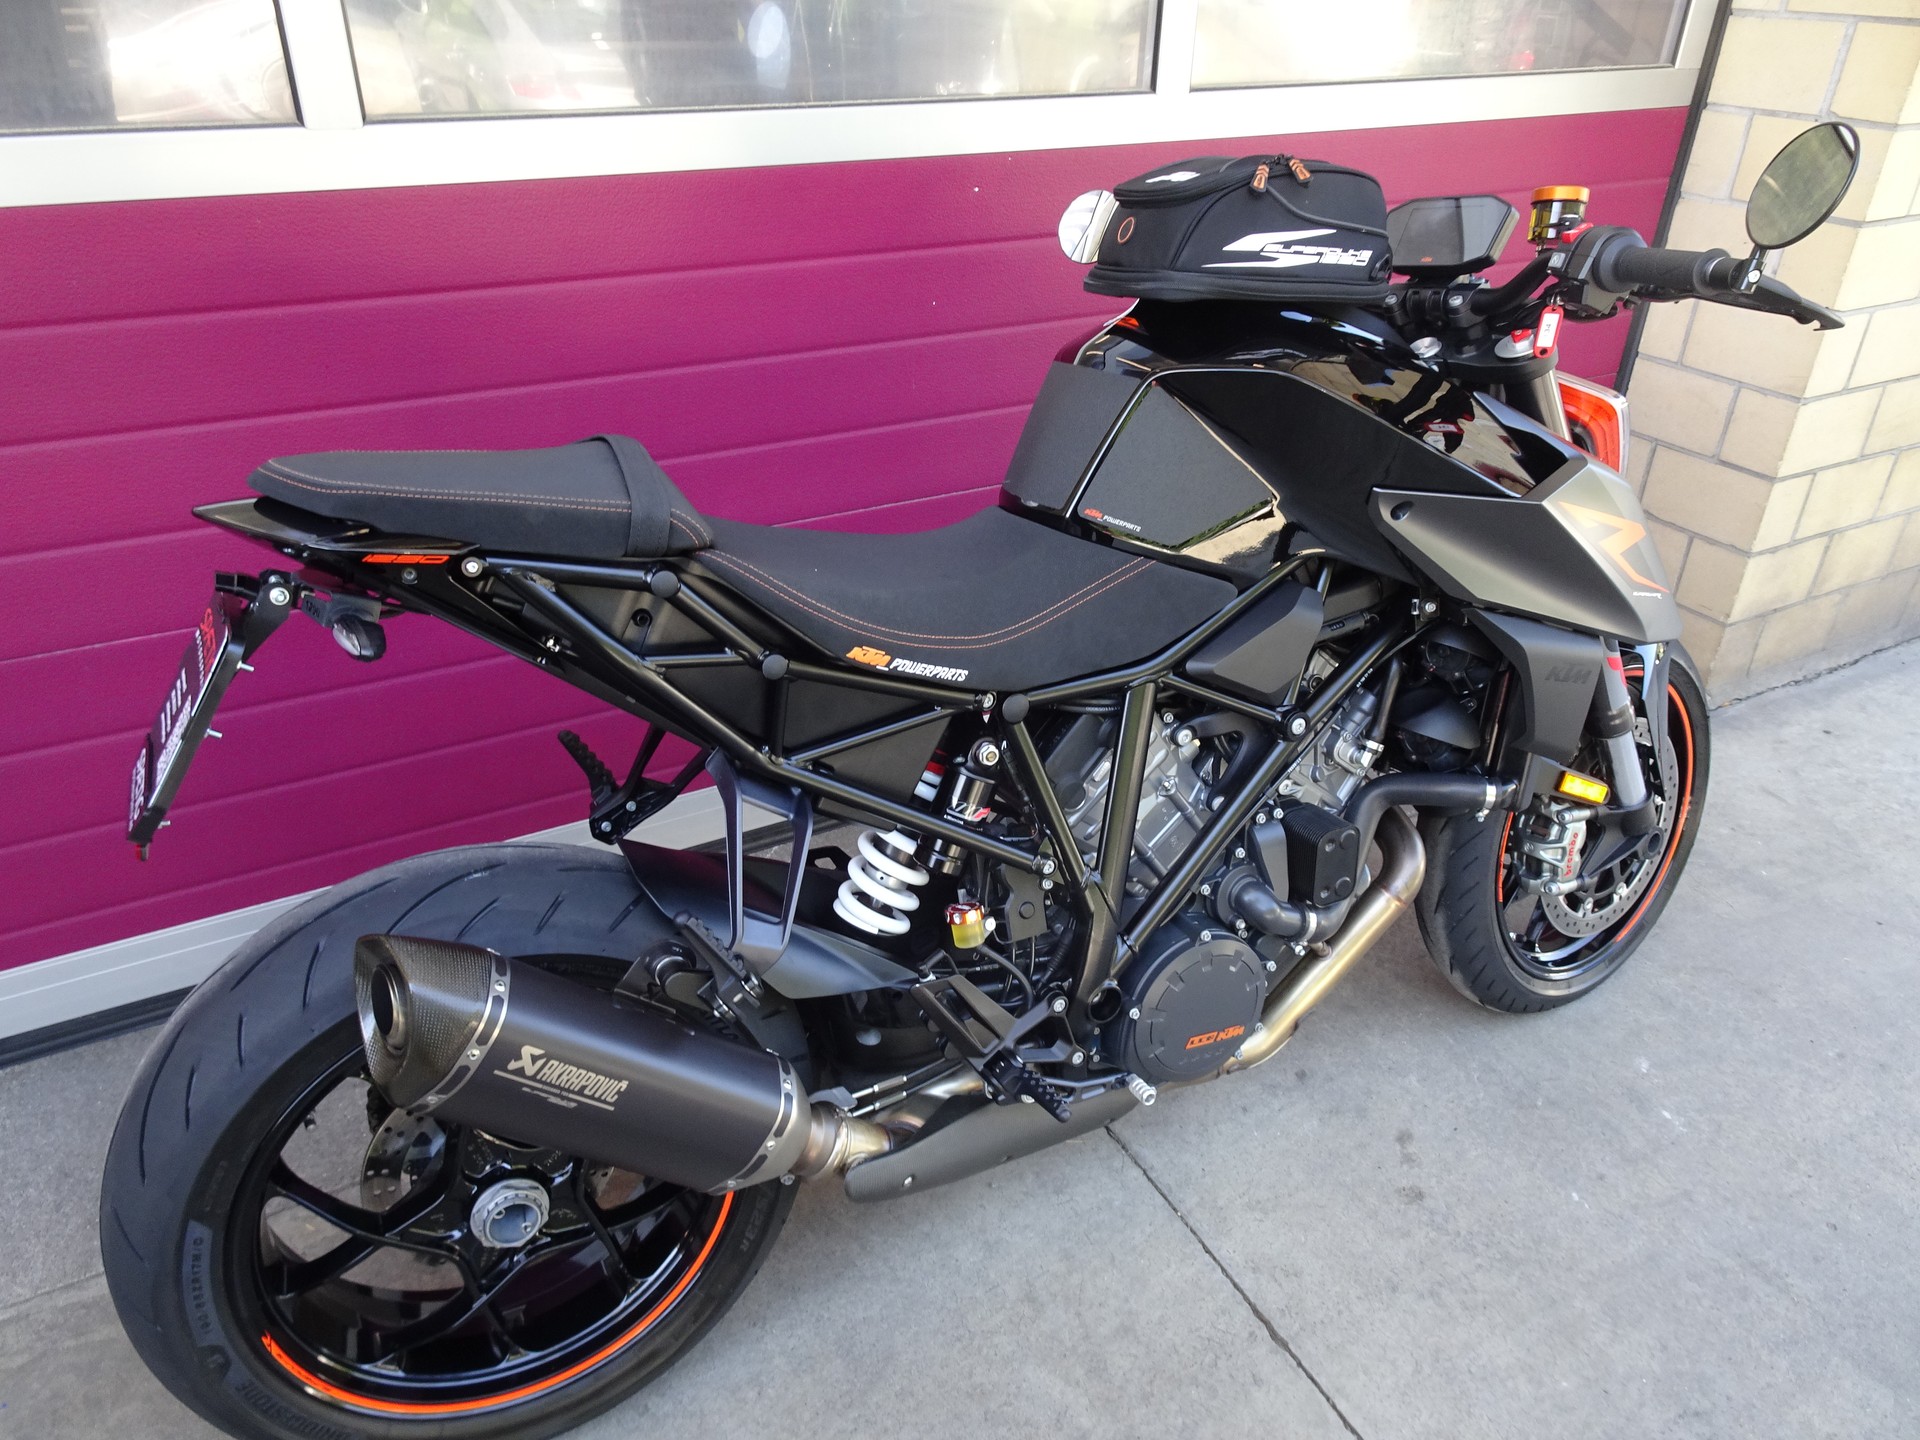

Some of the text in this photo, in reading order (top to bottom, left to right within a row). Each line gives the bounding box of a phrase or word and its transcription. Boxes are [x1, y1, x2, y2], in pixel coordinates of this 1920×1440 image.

[1103, 514, 1142, 532] POWERPARTS
[846, 645, 969, 682] KTM POWERPARTS
[1545, 663, 1593, 684] KTM
[1564, 832, 1578, 877] brembo
